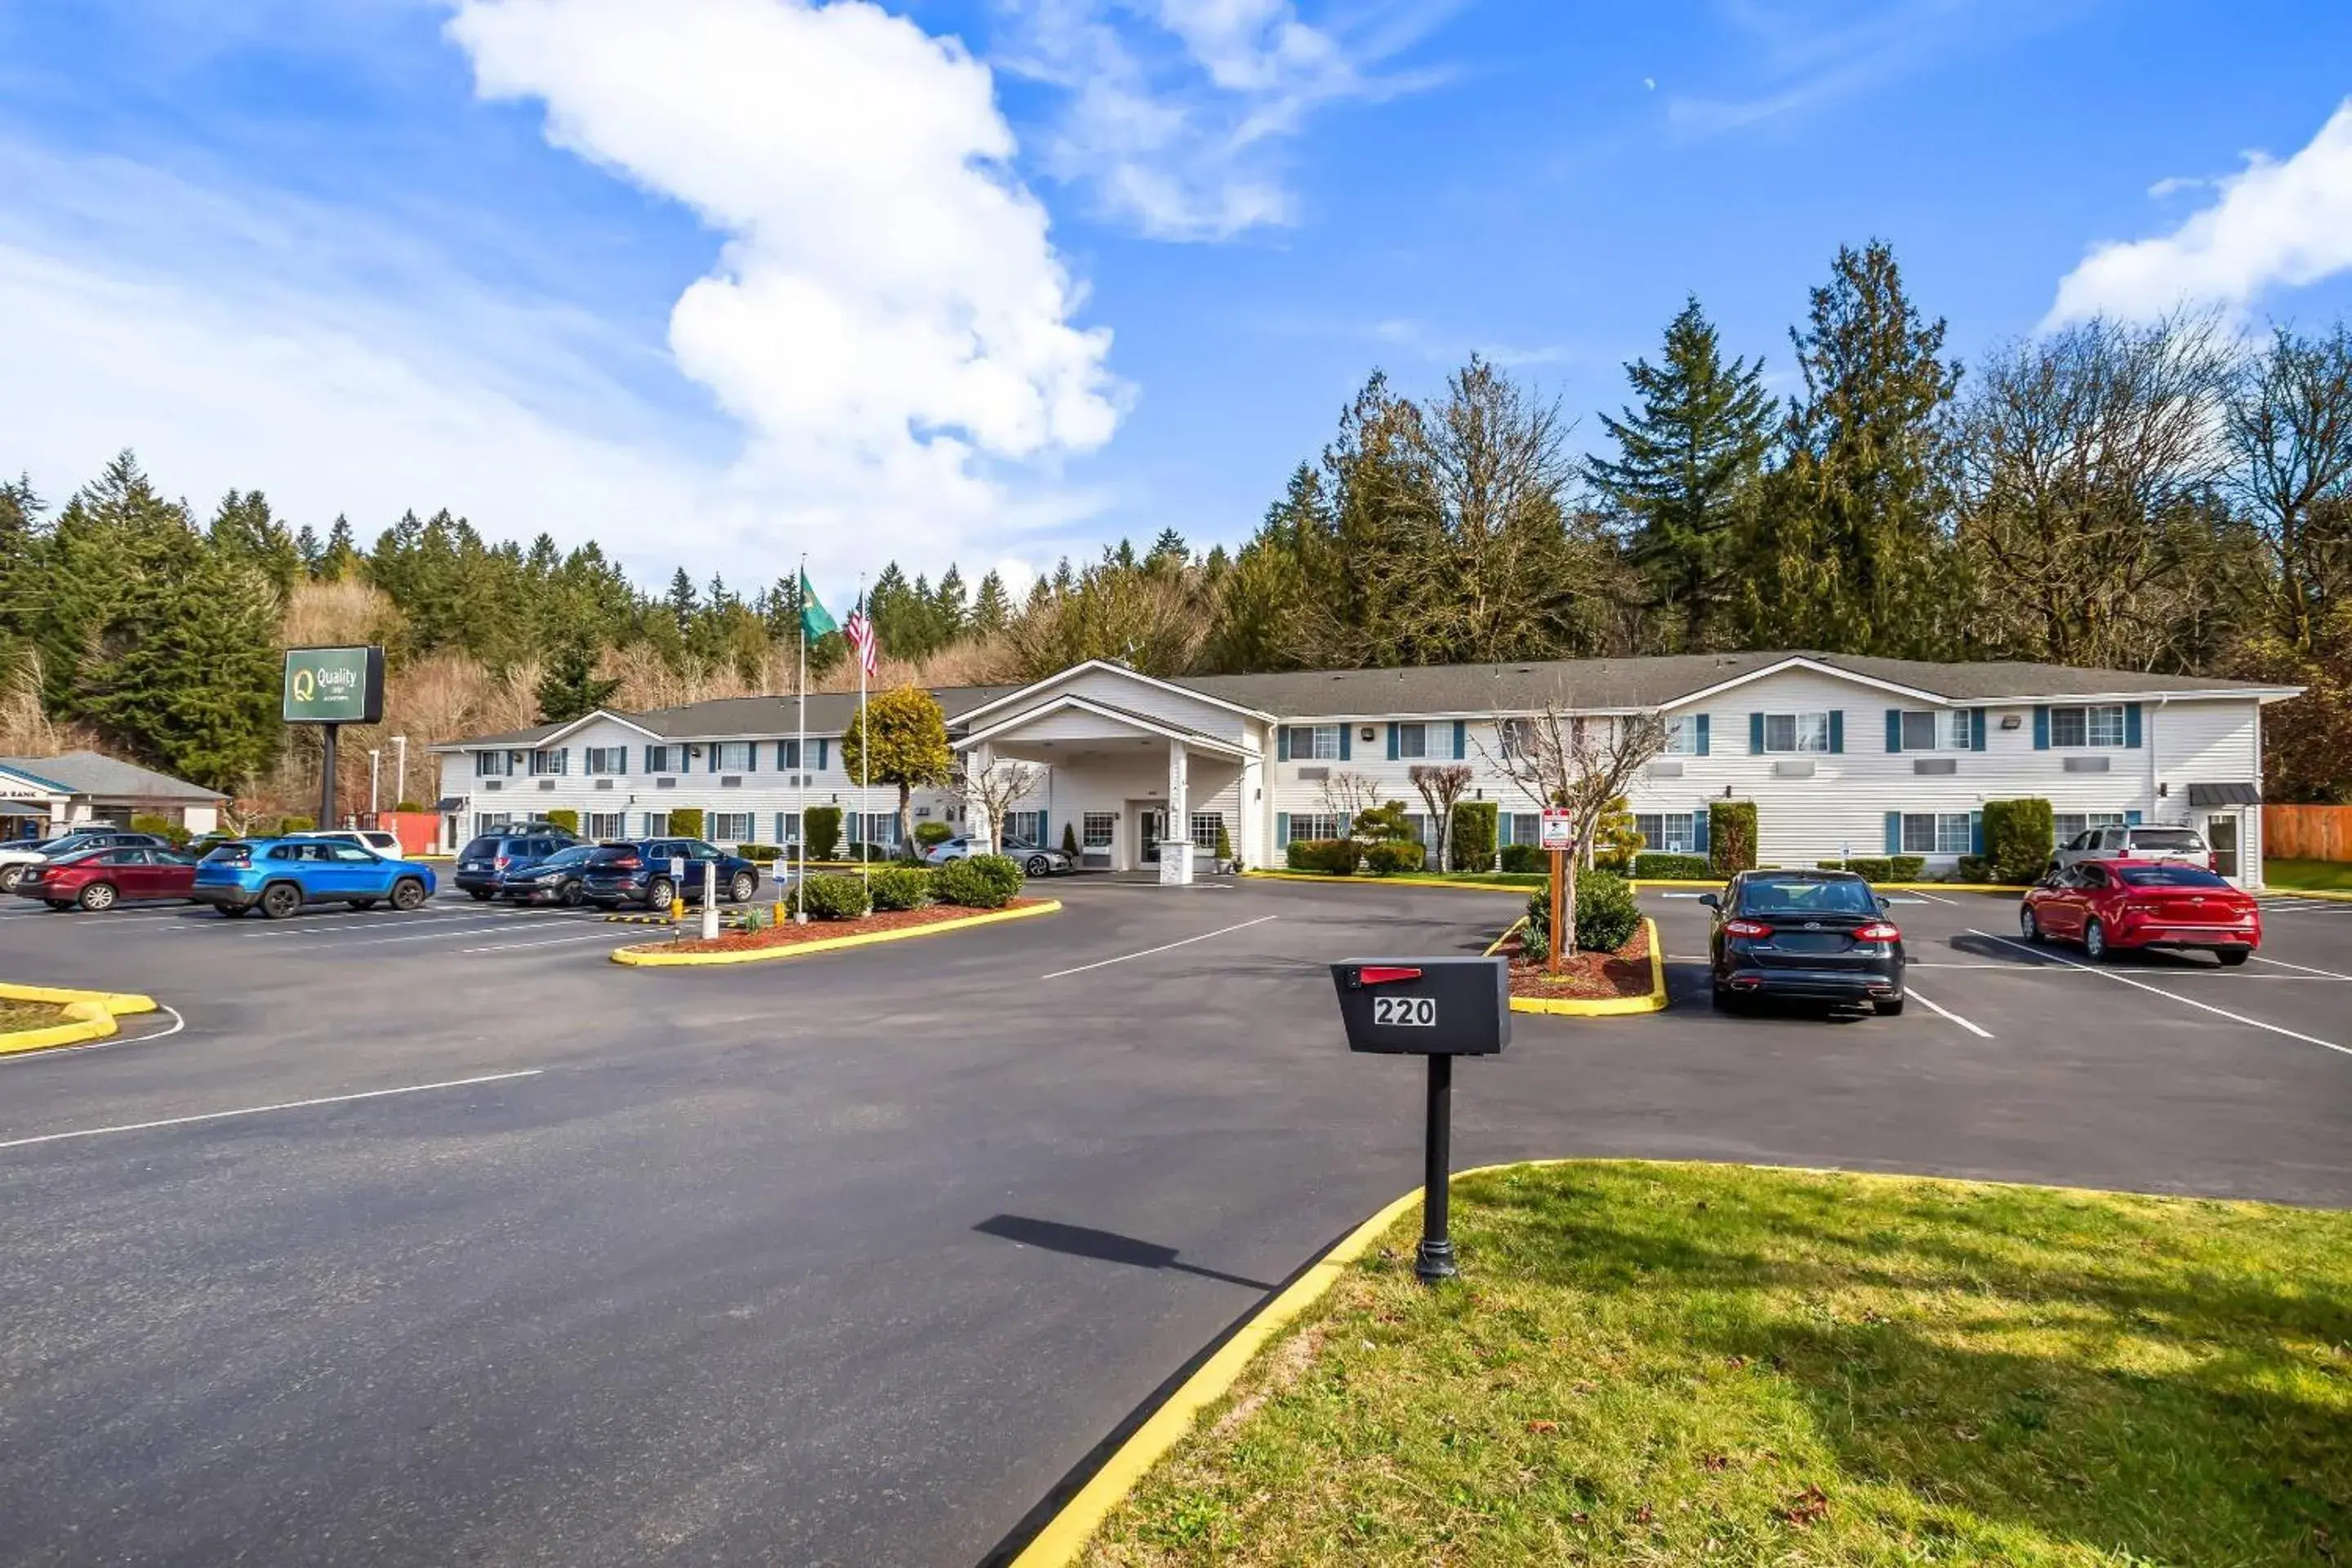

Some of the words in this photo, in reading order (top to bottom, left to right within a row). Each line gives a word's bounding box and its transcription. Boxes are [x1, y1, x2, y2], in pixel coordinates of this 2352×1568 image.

[294, 669, 314, 702] Q
[318, 667, 357, 688] Quality
[11, 790, 37, 798] BANK
[1377, 999, 1434, 1025] 220
